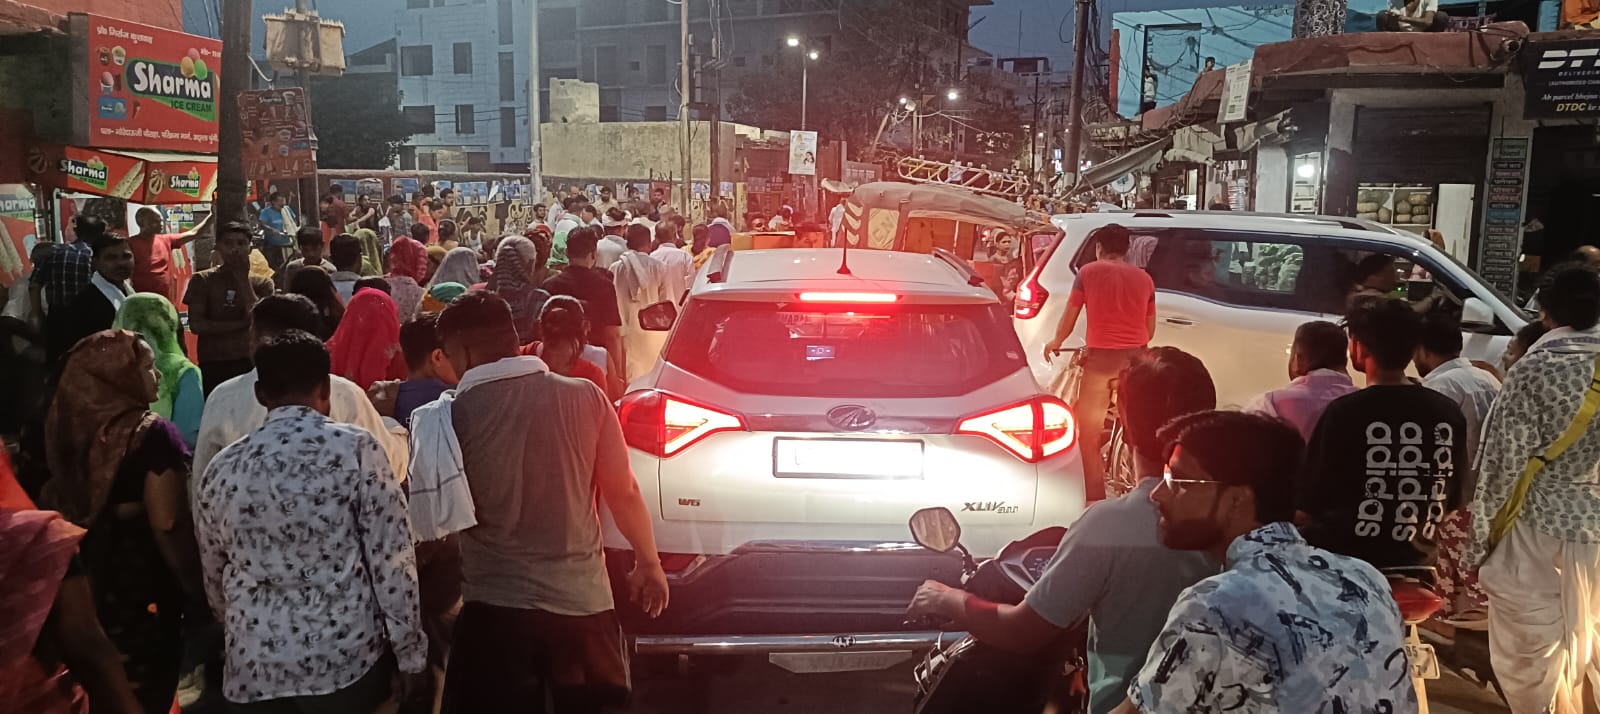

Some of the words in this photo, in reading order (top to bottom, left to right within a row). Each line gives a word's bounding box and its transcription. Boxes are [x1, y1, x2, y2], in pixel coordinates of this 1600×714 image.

[133, 61, 212, 99] Sharma
[171, 100, 185, 110] ICE
[185, 101, 212, 113] CREAM
[1556, 102, 1586, 112] DTDC
[60, 160, 105, 179] Sharma
[170, 175, 199, 188] Sharma
[1355, 421, 1397, 537] adidas
[1392, 421, 1430, 541] adidas
[1422, 422, 1454, 540] adidas
